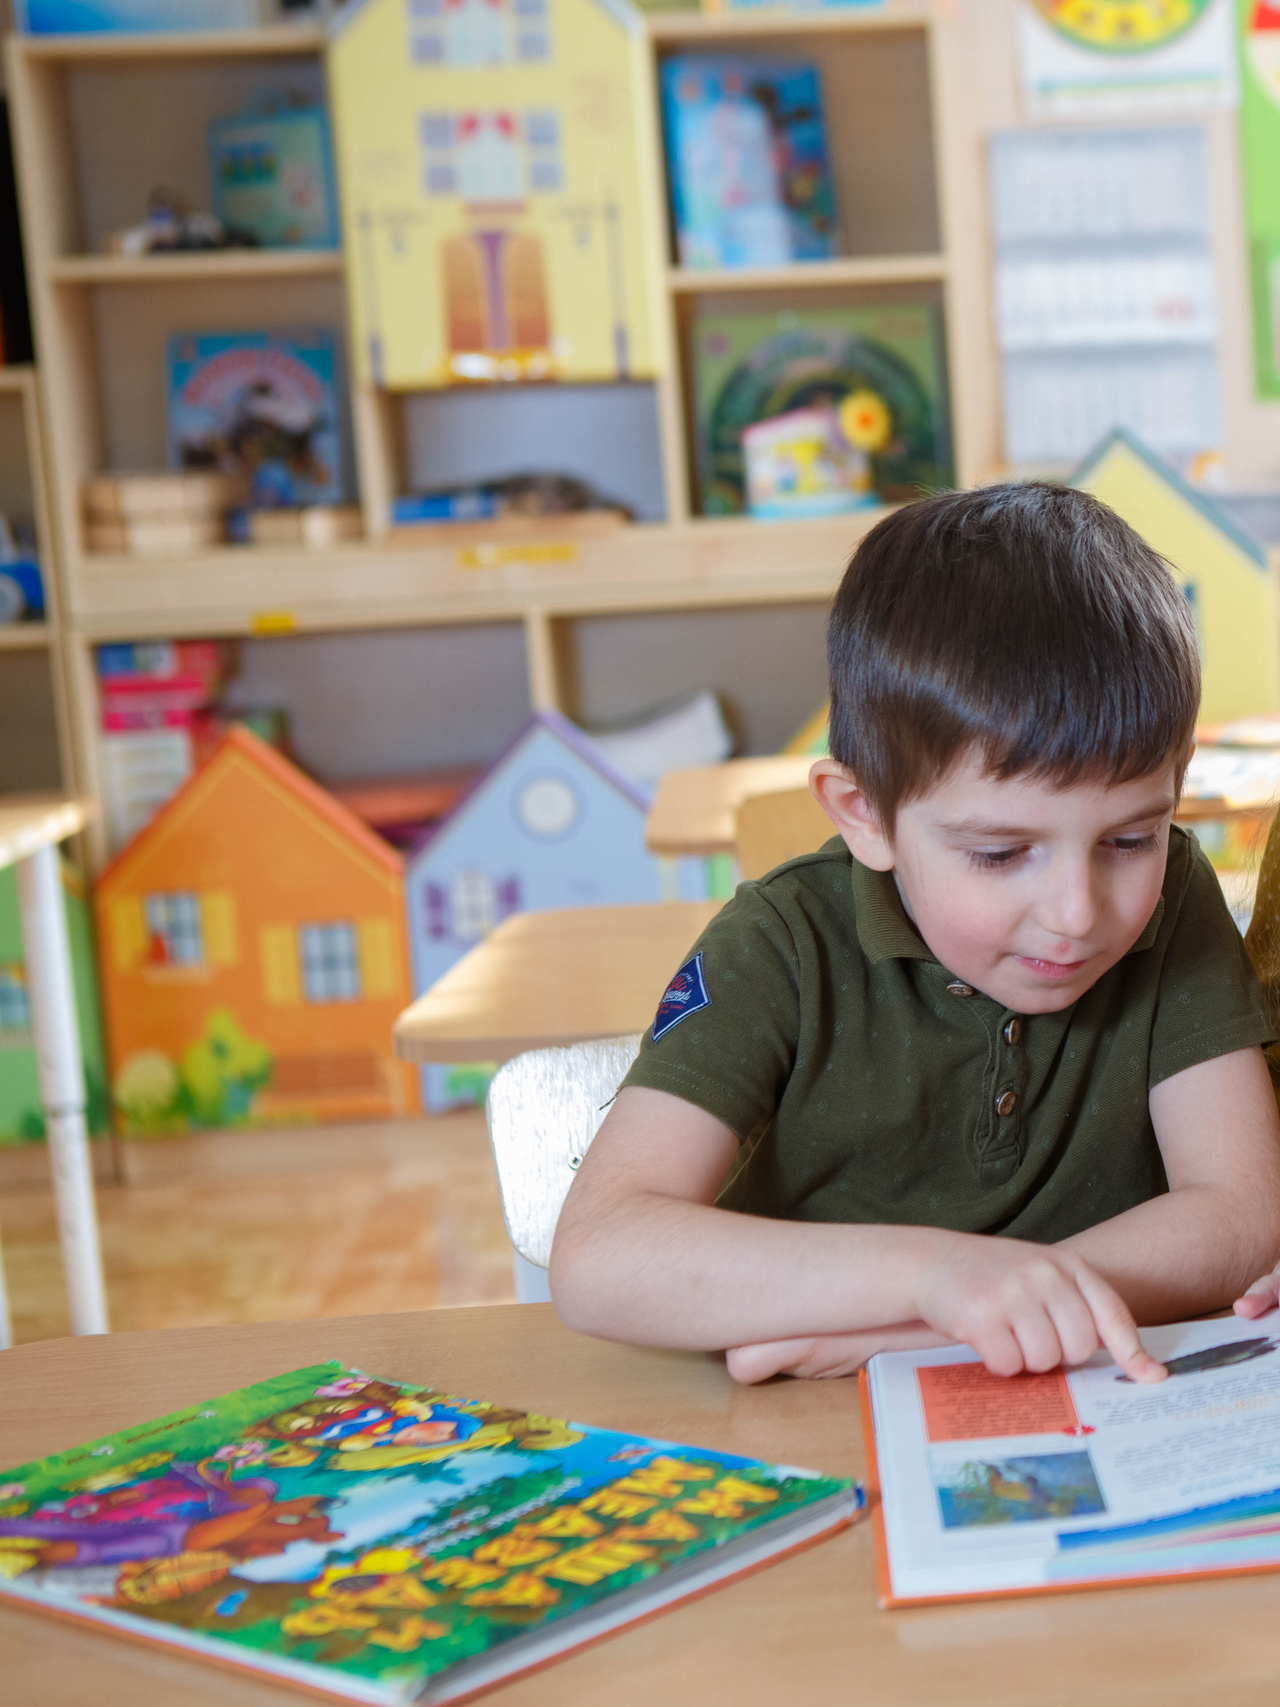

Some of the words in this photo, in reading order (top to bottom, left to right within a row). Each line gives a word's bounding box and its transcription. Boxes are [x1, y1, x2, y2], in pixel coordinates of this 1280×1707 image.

[280, 1456, 714, 1636] МЕДВЕДЬ
[462, 1476, 779, 1607] МАША
[367, 1614, 451, 1652] И
